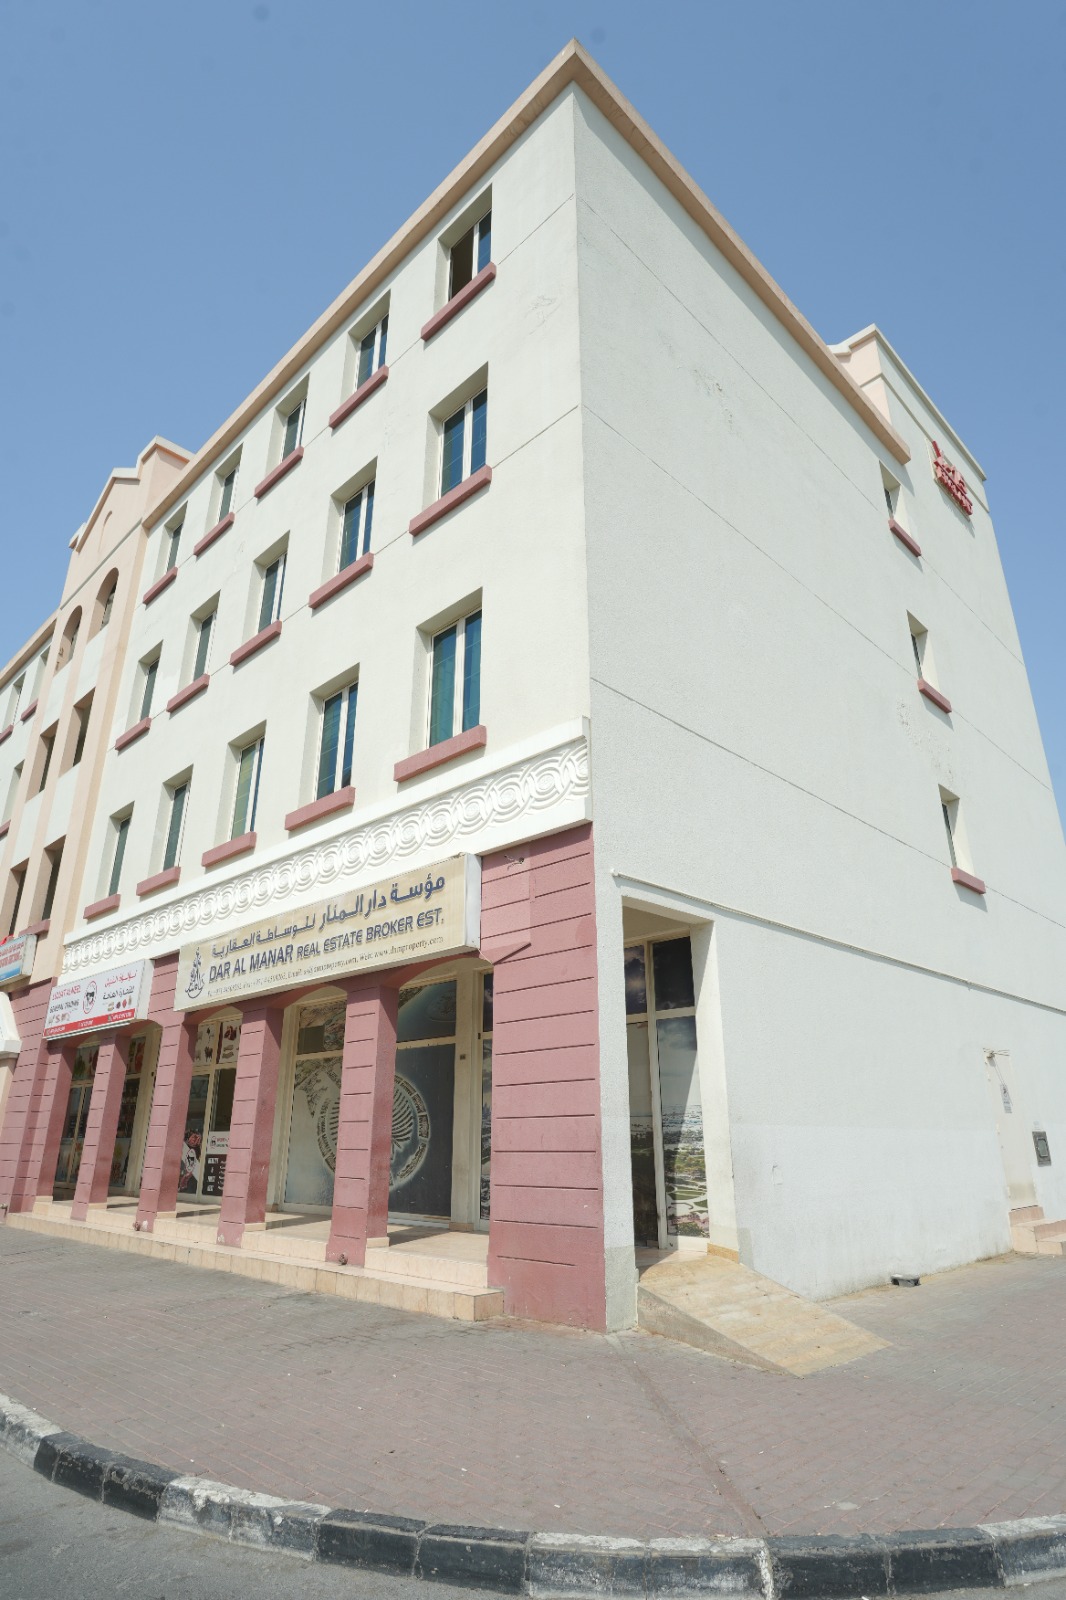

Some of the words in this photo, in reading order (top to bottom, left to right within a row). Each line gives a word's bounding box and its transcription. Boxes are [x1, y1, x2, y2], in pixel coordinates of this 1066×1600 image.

[319, 893, 364, 931] المنار
[364, 889, 387, 918] دار
[256, 913, 316, 943] للوساطة
[209, 961, 231, 982] DAR
[232, 957, 247, 977] AL
[250, 943, 294, 972] MANAR
[296, 941, 321, 960] REAL
[323, 929, 363, 952] ESTATE
[366, 915, 413, 943] BROKER
[416, 907, 444, 928] EST.
[212, 931, 256, 959] العقارية
